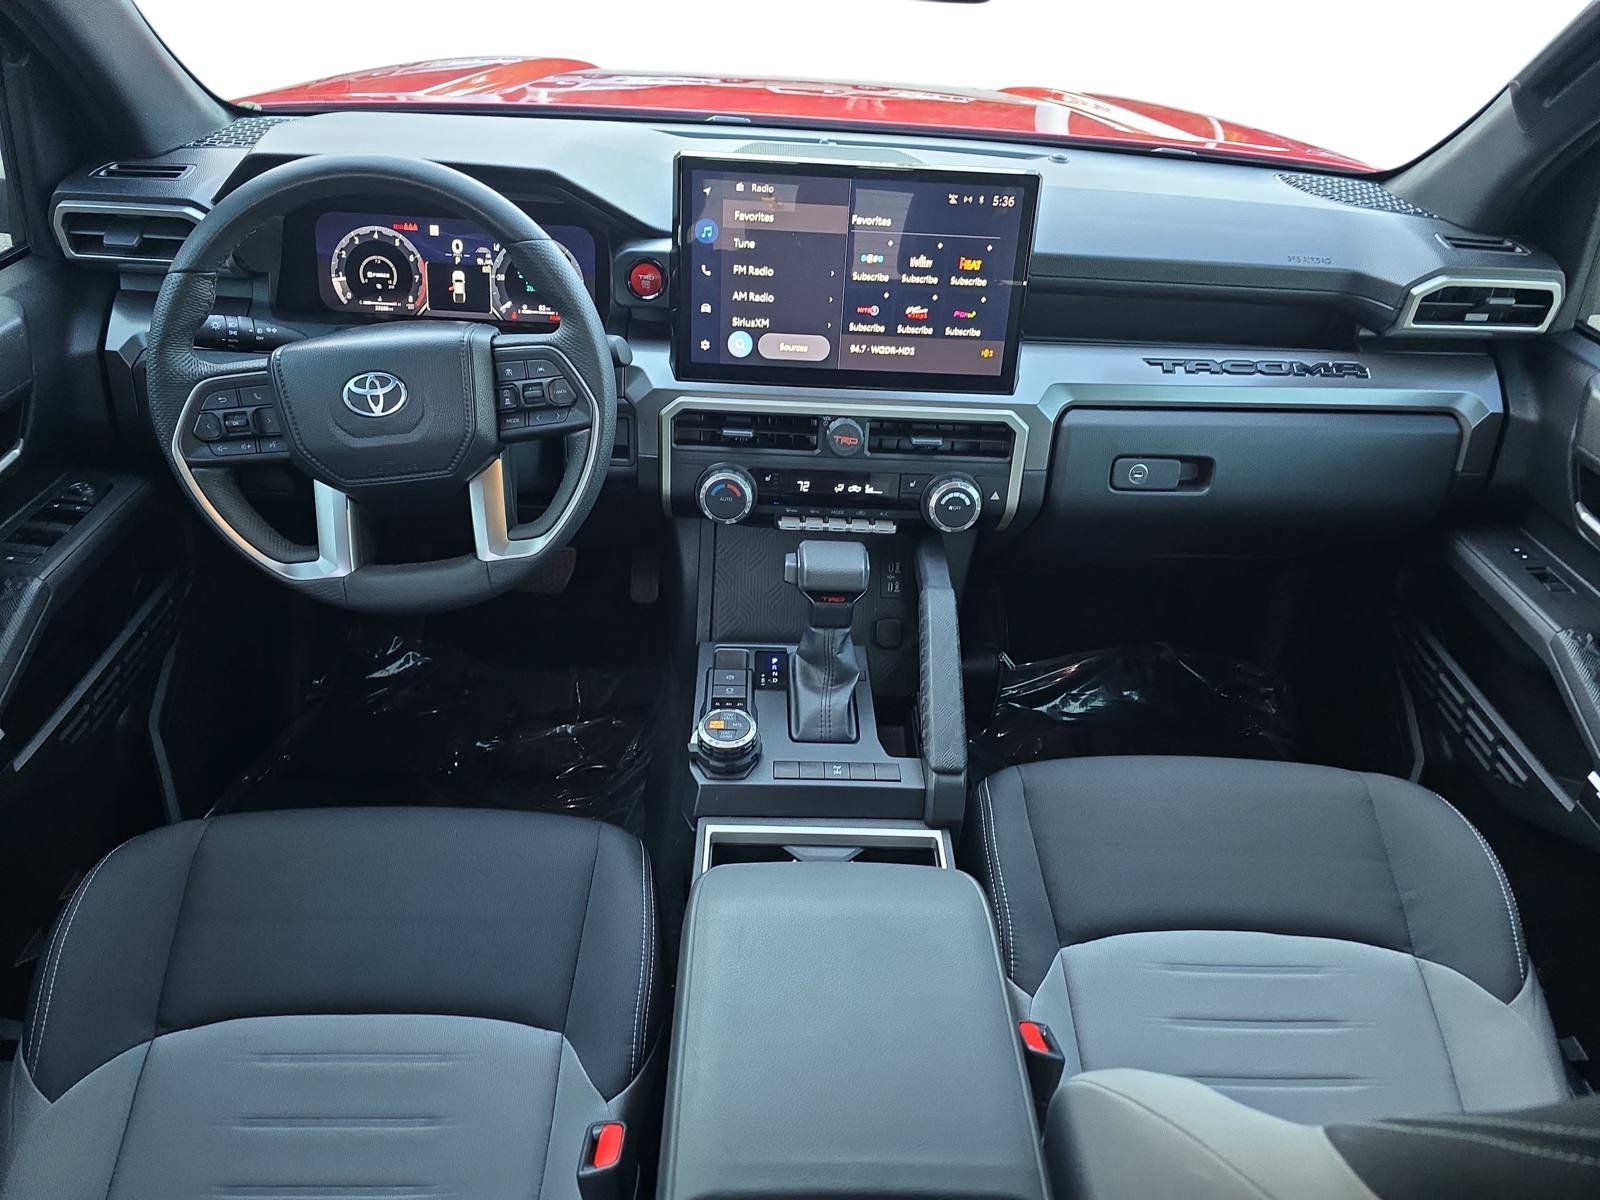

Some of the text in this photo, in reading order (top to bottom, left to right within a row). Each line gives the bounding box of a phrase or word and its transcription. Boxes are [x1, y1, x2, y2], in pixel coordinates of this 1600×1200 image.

[751, 183, 774, 193] Radio
[992, 195, 1015, 208] 5:36
[734, 210, 775, 223] Favorites
[851, 214, 892, 227] Favorites
[733, 237, 756, 249] Tune
[733, 264, 775, 277] FM Radio
[852, 271, 890, 283] Subscribe
[901, 273, 939, 285] Subscribe
[950, 275, 988, 287] Subscribe
[732, 290, 775, 303] AM Radio
[731, 316, 770, 329] SiriusXM
[848, 322, 886, 333] Subscribe
[896, 324, 934, 335] Subscribe
[944, 326, 982, 338] Subscribe
[779, 342, 809, 354] Sources
[849, 344, 866, 354] 94.7
[1142, 357, 1372, 379] TACOMA
[832, 434, 859, 447] TRD
[797, 480, 811, 492] 72
